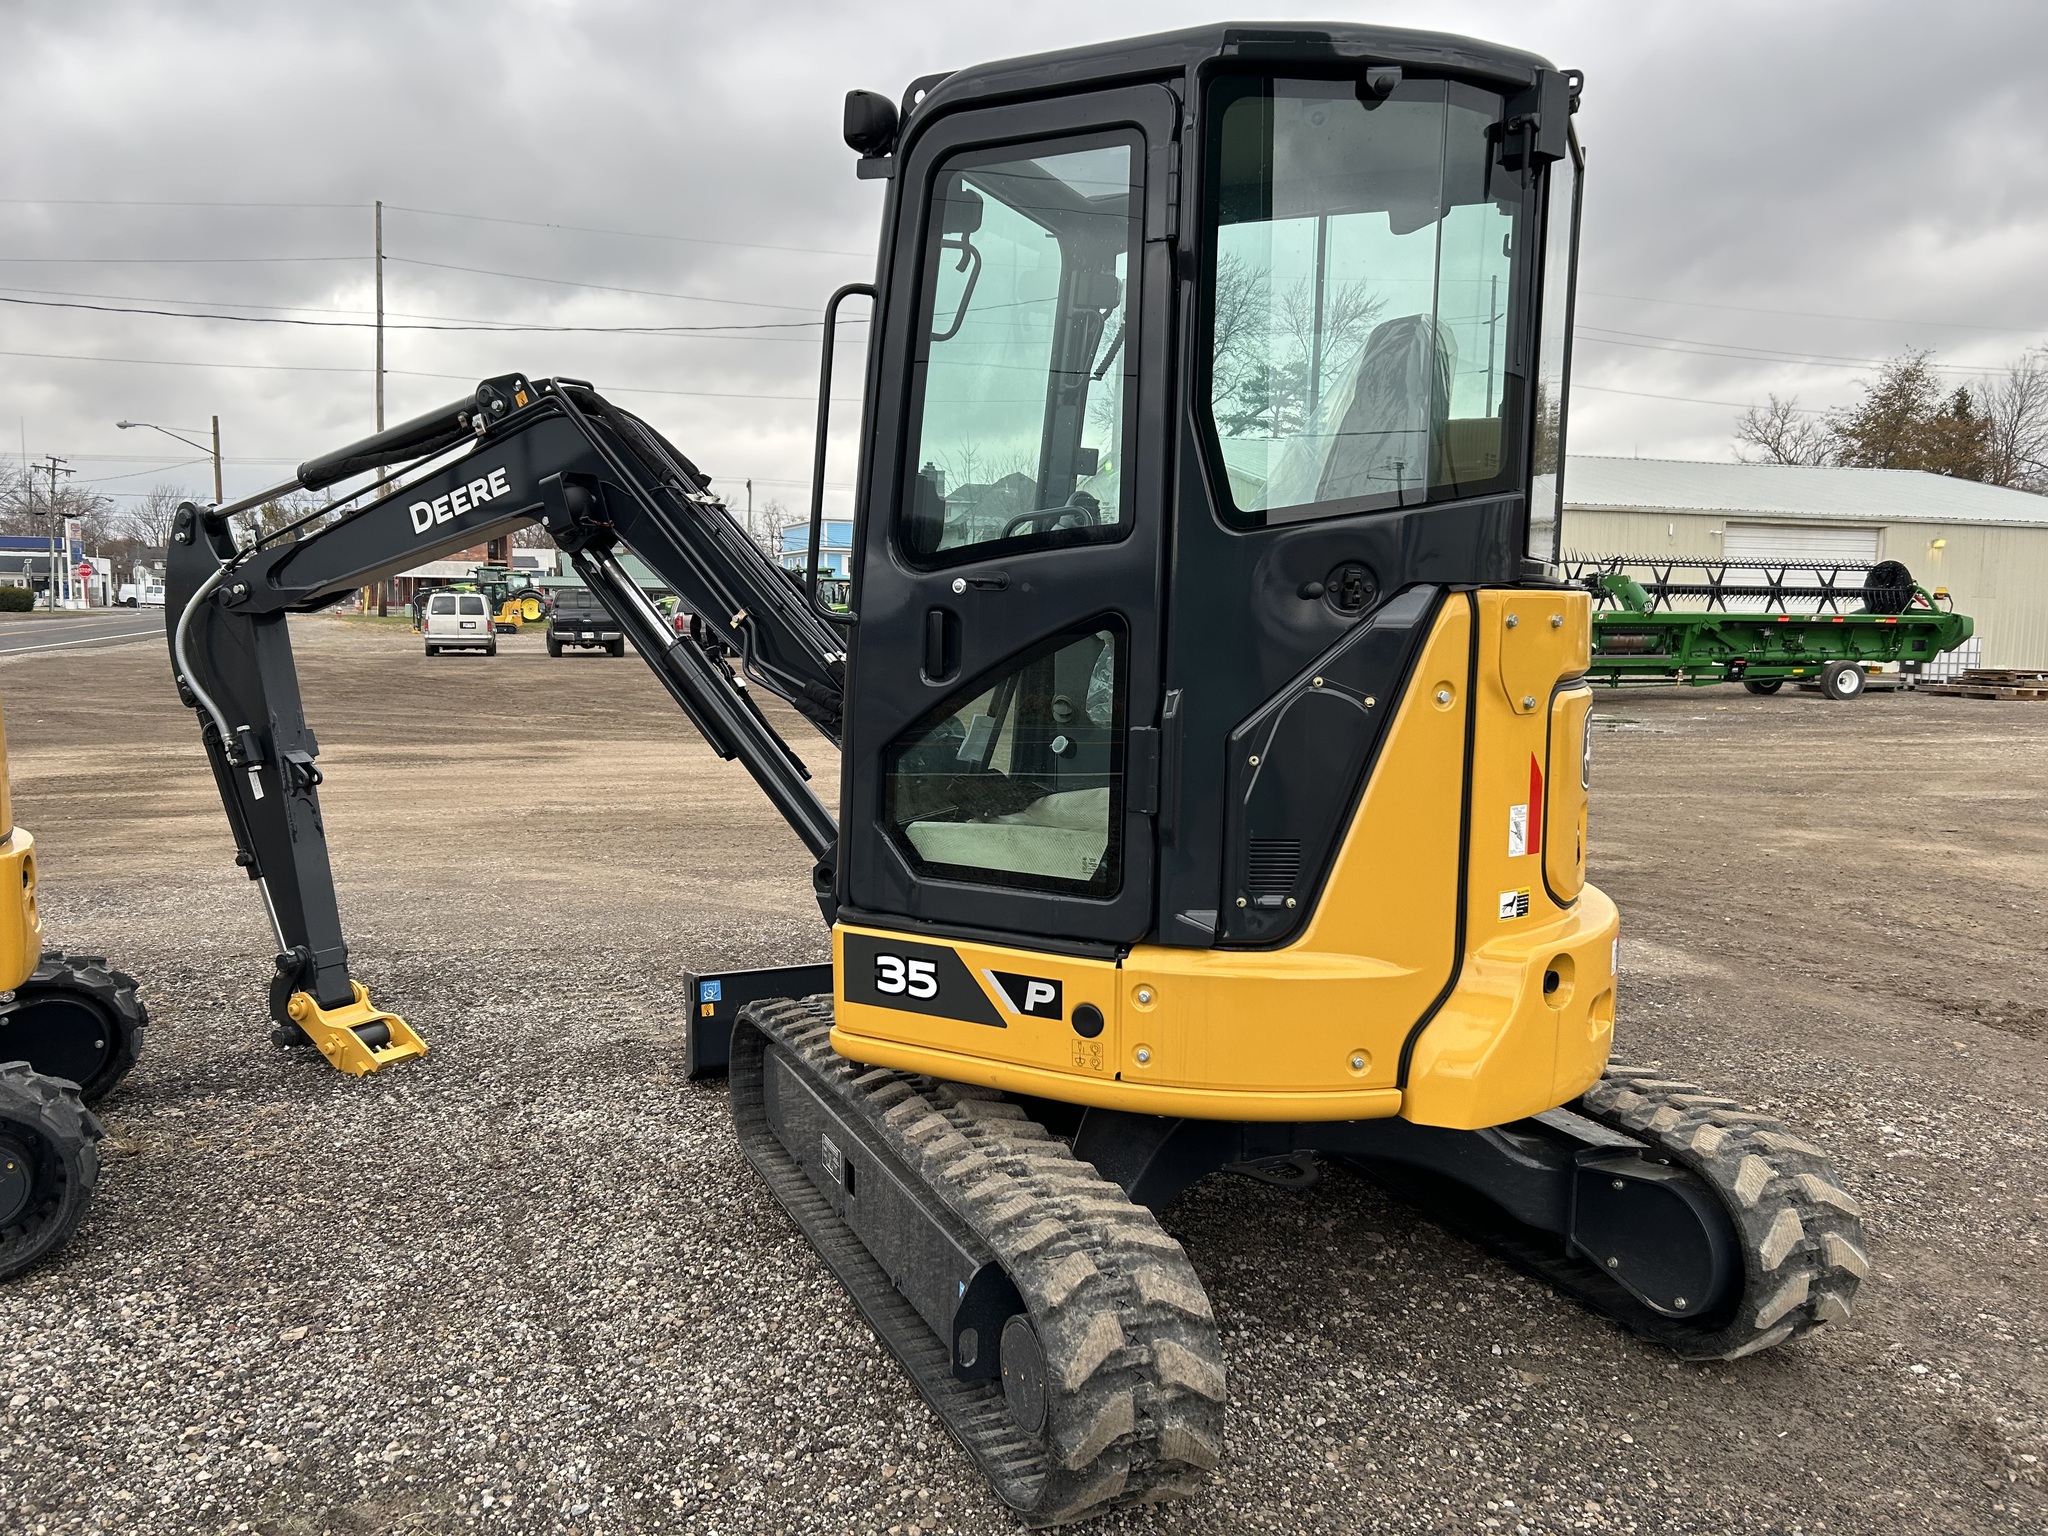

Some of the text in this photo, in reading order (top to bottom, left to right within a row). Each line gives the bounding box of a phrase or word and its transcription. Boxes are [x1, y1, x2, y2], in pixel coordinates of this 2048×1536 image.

[409, 467, 511, 535] DEERE
[876, 955, 938, 999] 35
[1024, 980, 1056, 1012] P
